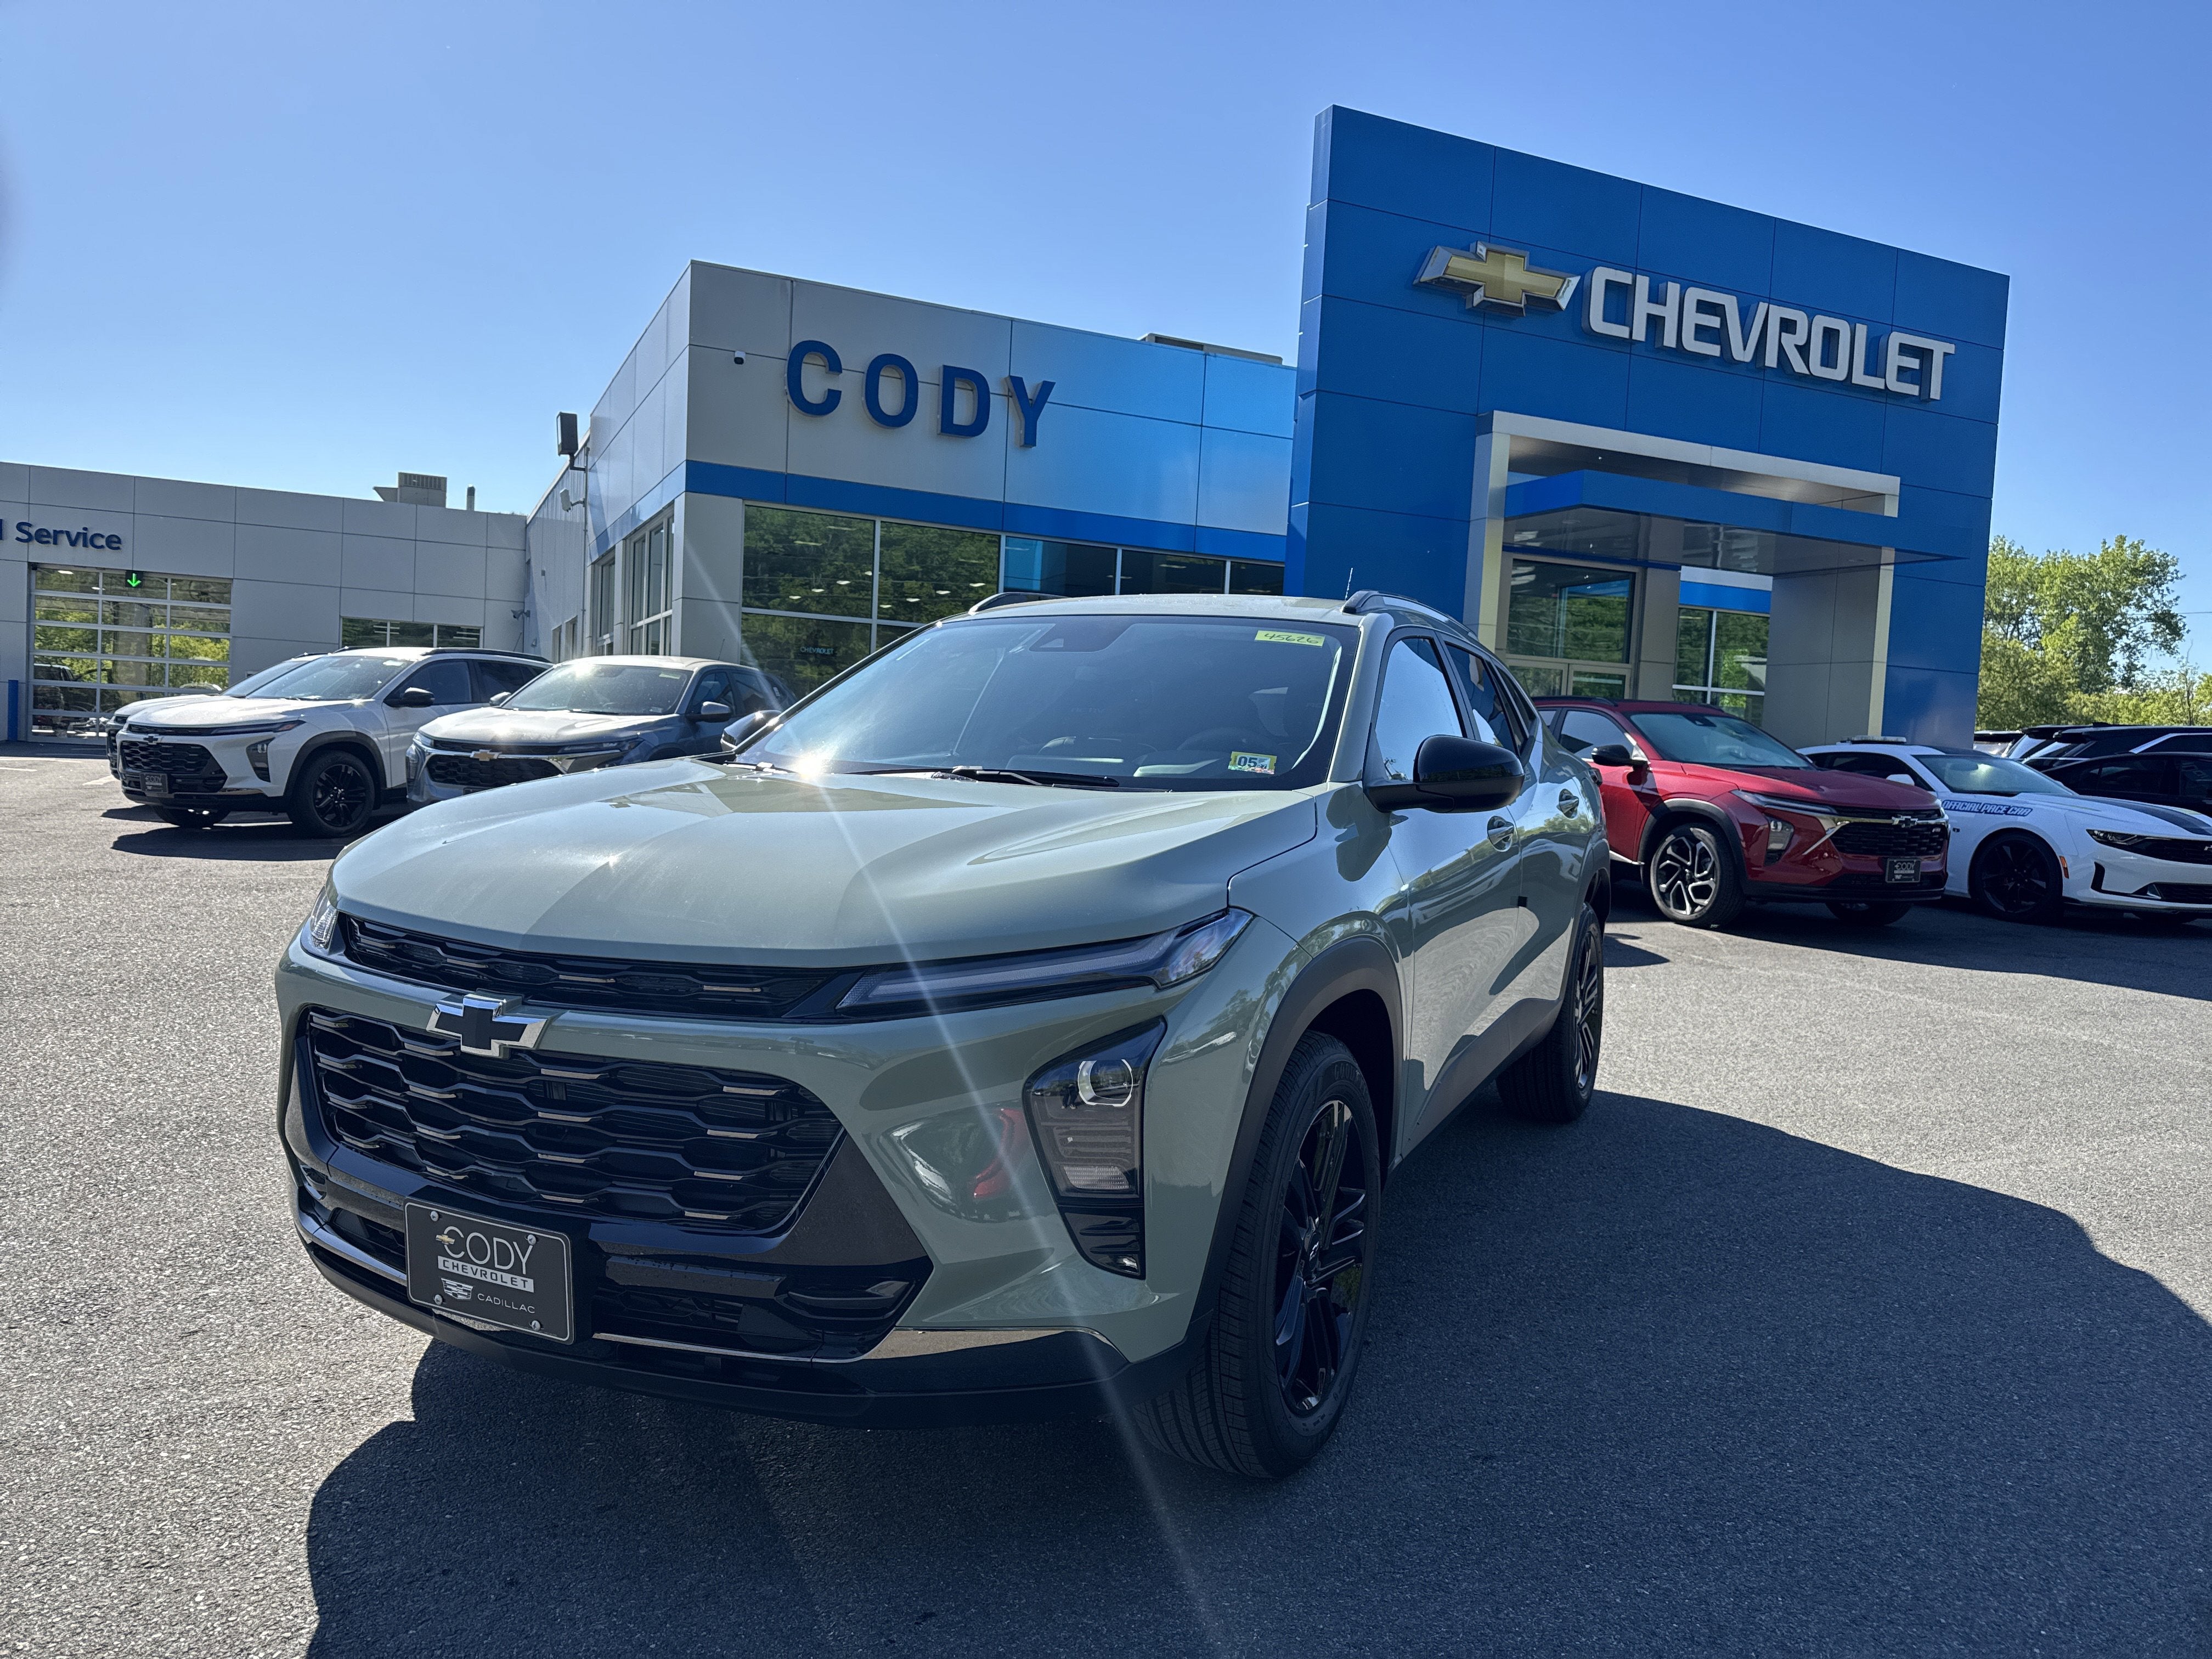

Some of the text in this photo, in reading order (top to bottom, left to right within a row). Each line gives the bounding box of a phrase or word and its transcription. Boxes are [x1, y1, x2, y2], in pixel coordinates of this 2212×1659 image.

[1583, 266, 1955, 401] CHEVROLET
[785, 340, 1056, 448] CODY
[15, 521, 122, 550] Service
[1264, 633, 1319, 644] 45626
[1238, 756, 1258, 768] 05
[1943, 800, 1980, 811] OFFICIAL
[1980, 803, 2007, 814] PACE
[442, 1226, 533, 1275] CODY
[443, 1259, 528, 1289] CHEVROLET
[477, 1293, 535, 1314] CADILLAC
